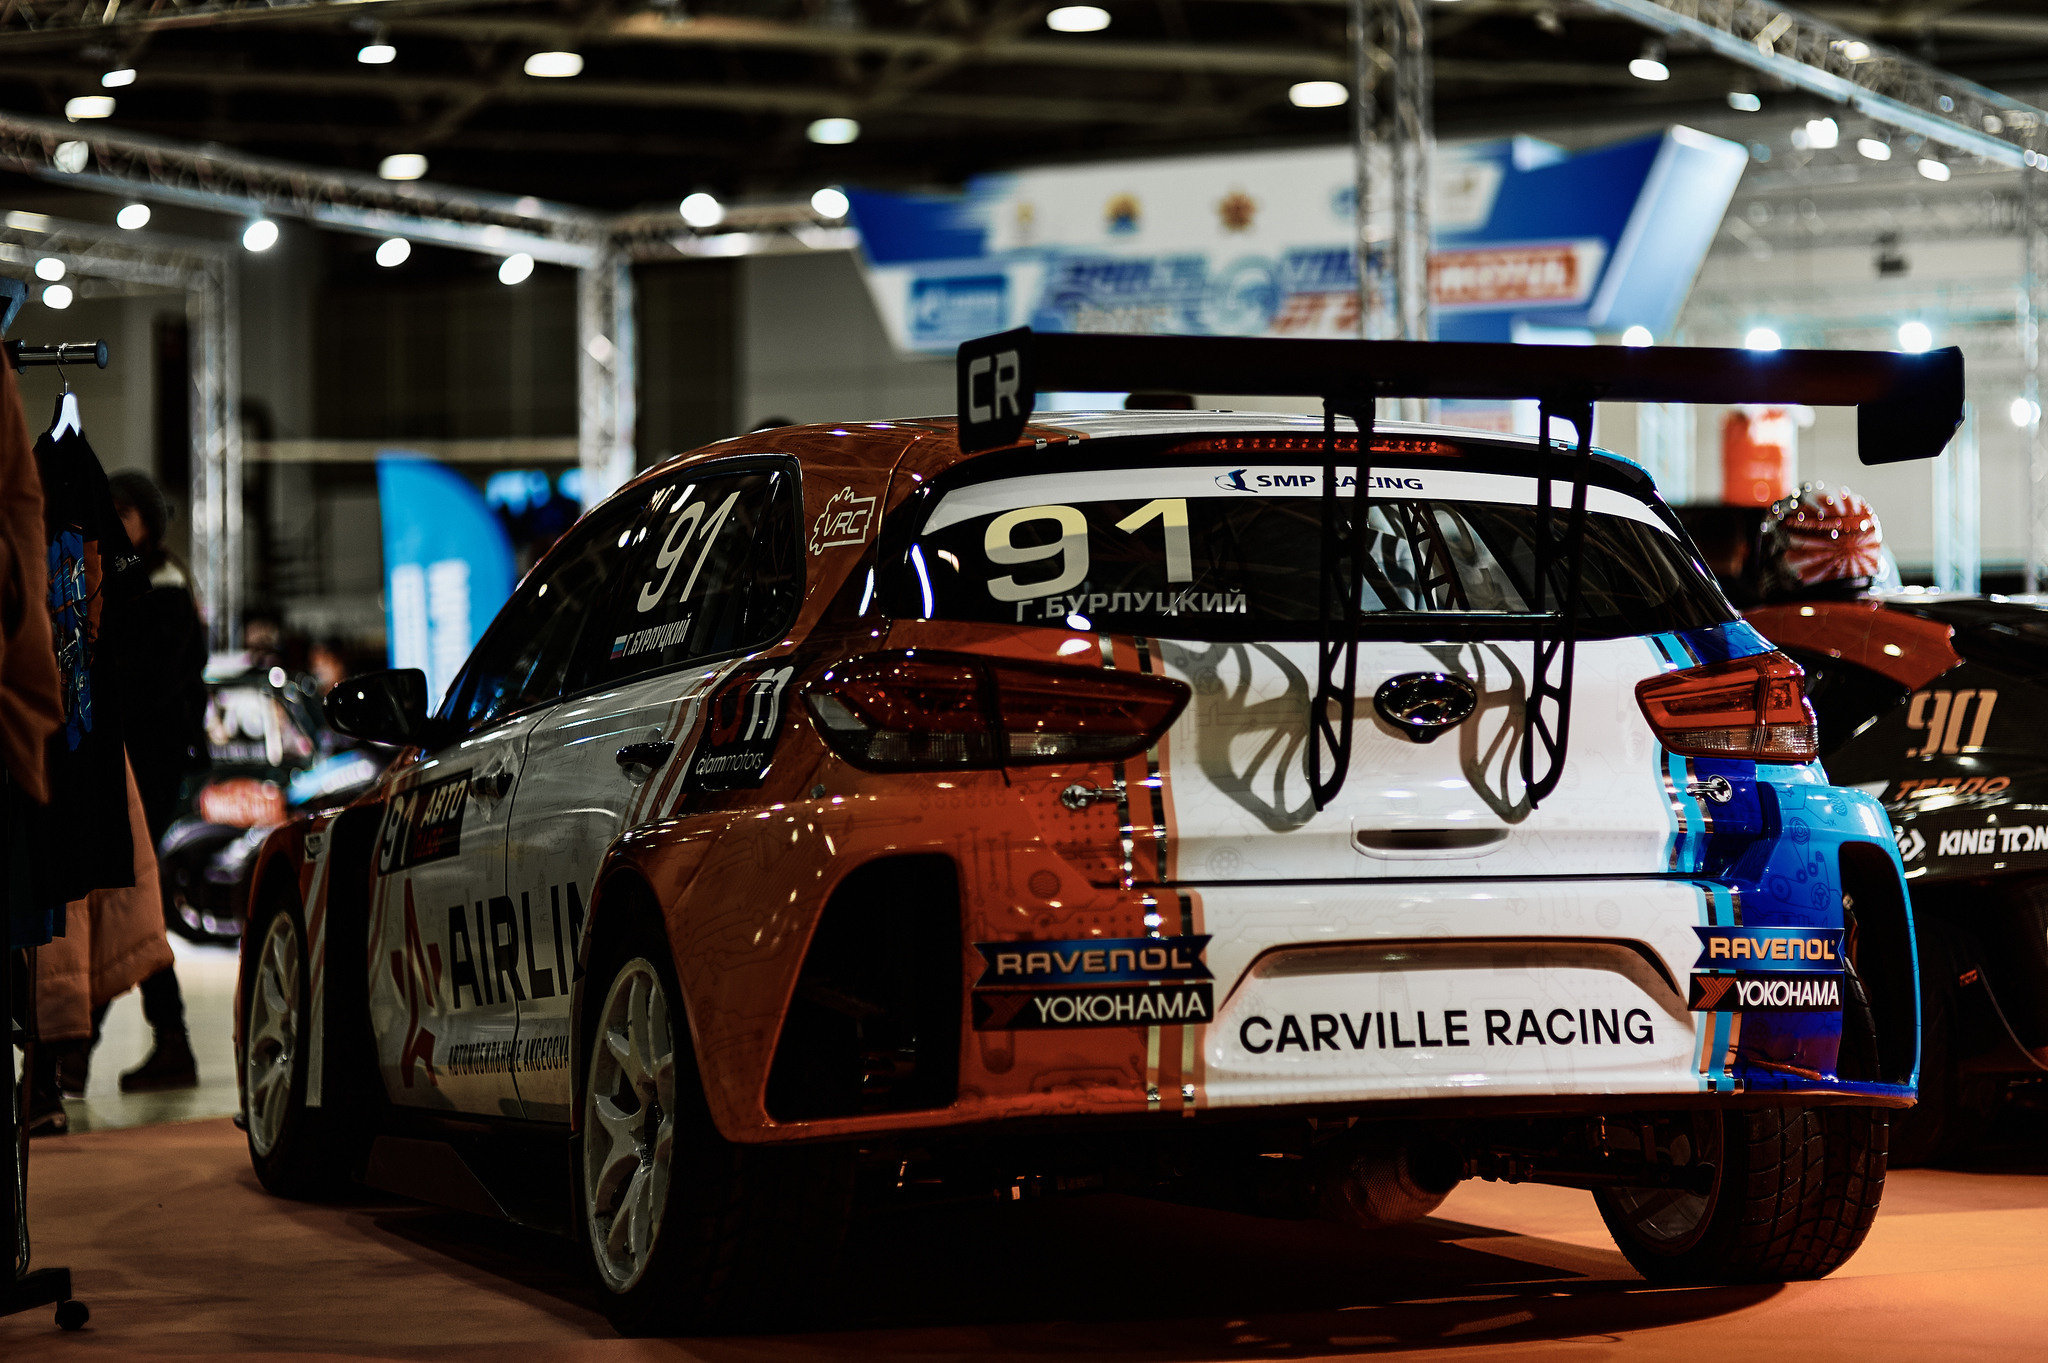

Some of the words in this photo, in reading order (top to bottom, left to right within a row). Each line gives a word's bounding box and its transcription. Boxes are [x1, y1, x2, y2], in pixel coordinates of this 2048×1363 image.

[968, 350, 1020, 424] CR
[1255, 475, 1316, 488] SMP
[823, 509, 868, 537] VRC
[637, 490, 742, 613] 91
[983, 498, 1194, 602] 91
[1016, 587, 1247, 623] Г.БУРЛУЦКИЙ
[621, 612, 693, 658] Г.БУРЛУЦКИЙ
[1905, 687, 1999, 759] 90
[380, 788, 419, 872] 91
[1938, 827, 1997, 857] KING
[996, 947, 1193, 976] RAVENOL
[1709, 936, 1836, 961] RAVENOL
[1033, 991, 1207, 1025] YOKOHAMA
[1735, 980, 1840, 1007] YOKOHAMA
[1238, 1010, 1471, 1055] CARVILLE
[1484, 1008, 1656, 1047] RACING
